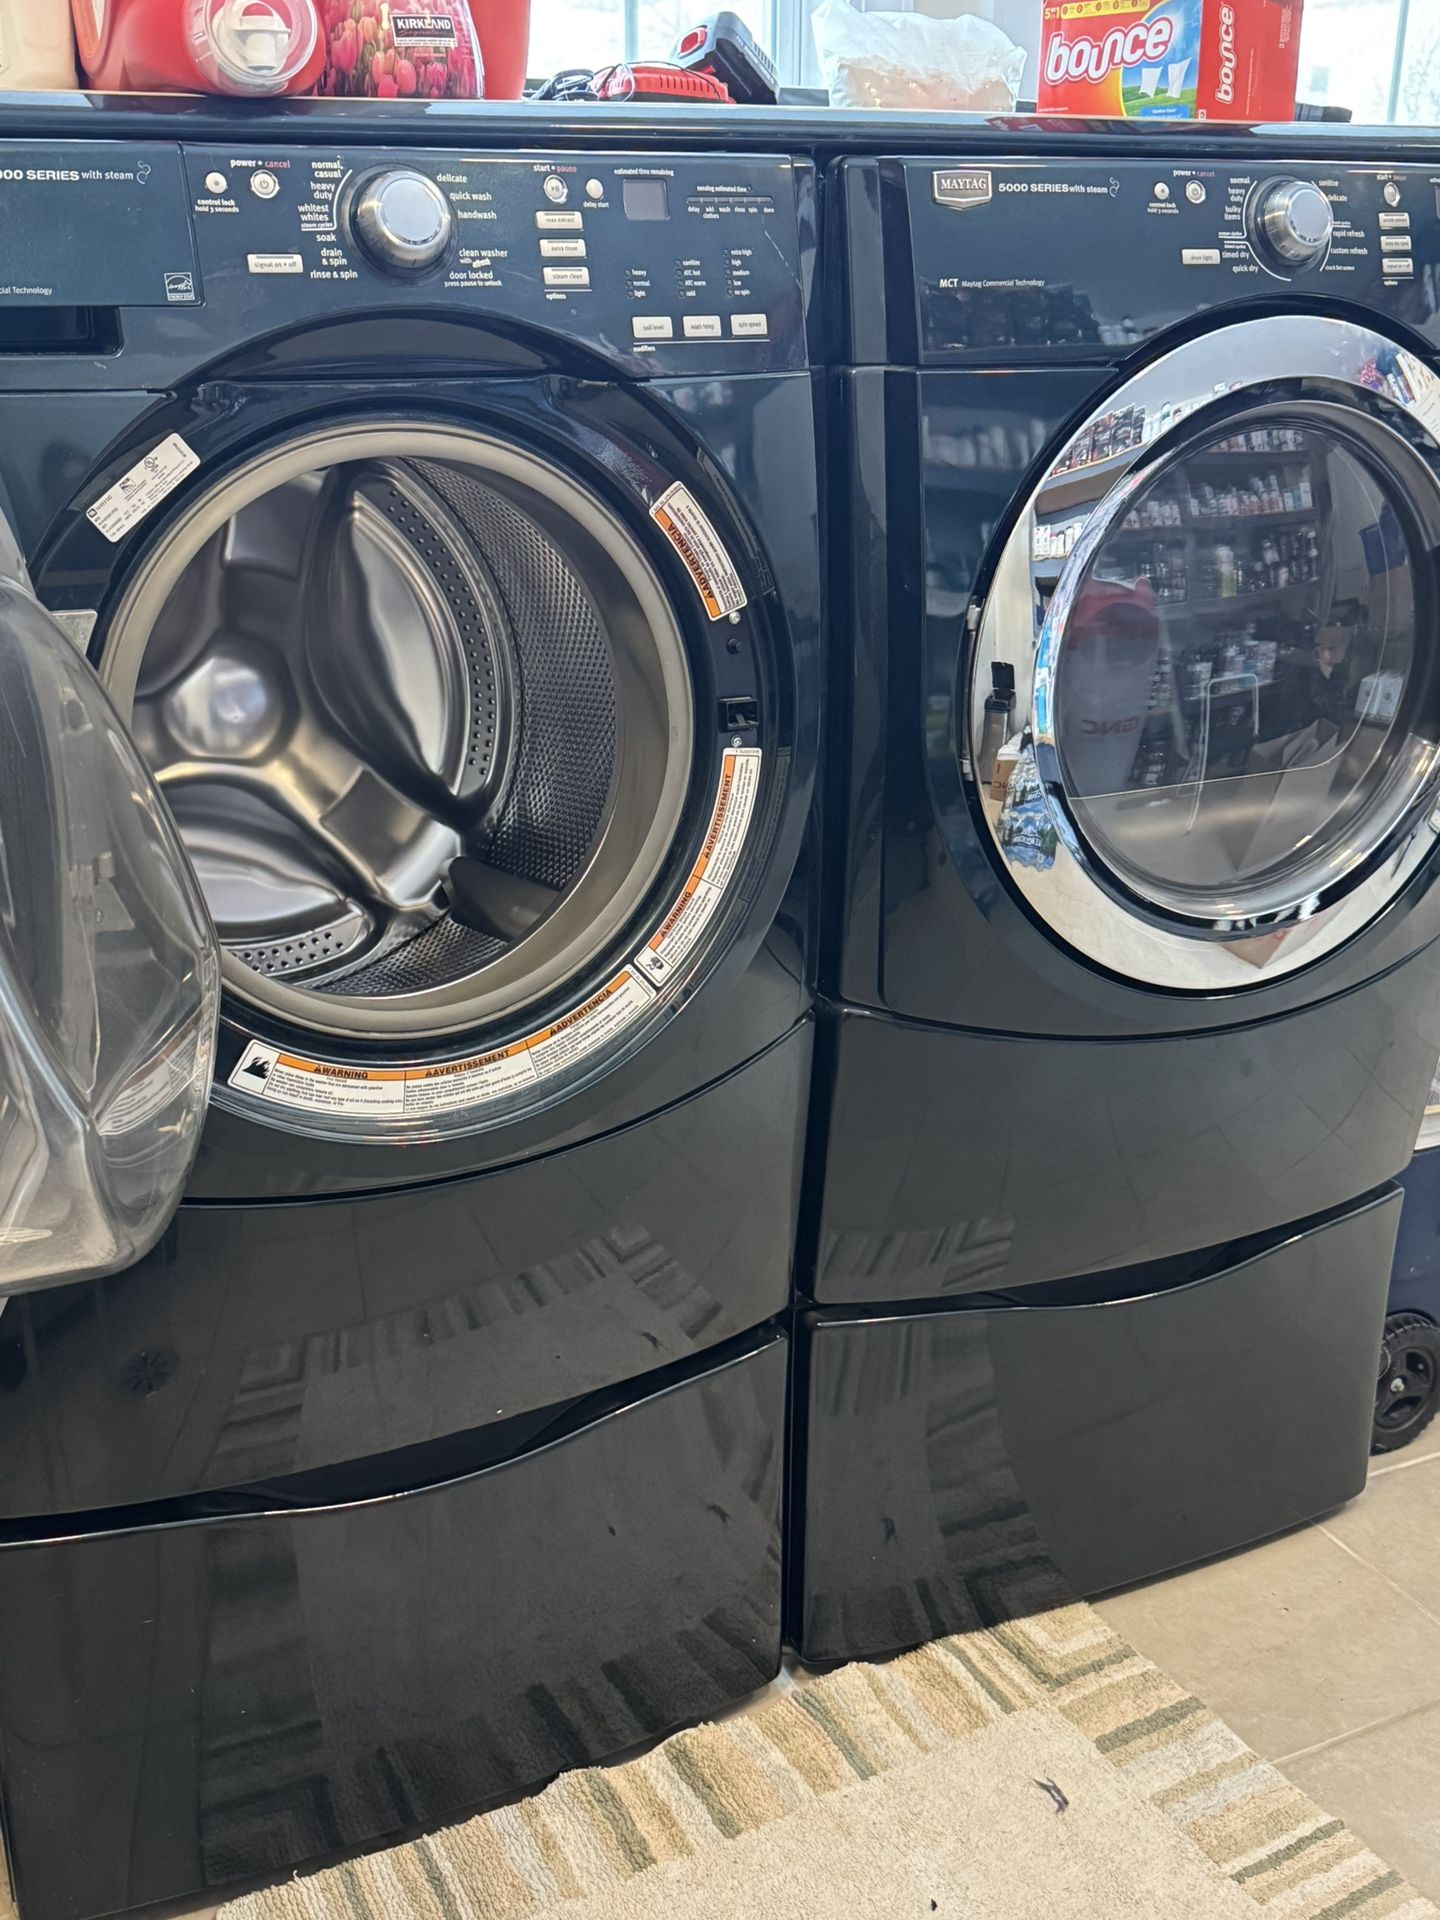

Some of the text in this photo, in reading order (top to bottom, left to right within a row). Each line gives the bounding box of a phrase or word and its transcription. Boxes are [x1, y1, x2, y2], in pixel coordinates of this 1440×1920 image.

[396, 18, 451, 29] KIRKLAND
[1046, 18, 1172, 80] bounce
[1216, 6, 1235, 102] bounce
[230, 160, 290, 168] power cancel
[26, 170, 80, 181] SERIES
[82, 170, 102, 180] with
[104, 172, 134, 181] steam
[314, 170, 342, 178] casual
[437, 174, 467, 183] delicate
[310, 182, 335, 191] heavy
[941, 178, 986, 190] MAYTAG
[998, 183, 1108, 194] 5000 SERIES with steam
[314, 191, 332, 200] duty
[450, 192, 492, 200] quick wash
[298, 203, 329, 212] whitest
[300, 213, 328, 221] whites
[458, 210, 496, 220] handwash
[316, 232, 336, 241] soak
[321, 248, 342, 257] drain
[459, 248, 508, 258] clean washer
[1240, 251, 1250, 259] dry
[254, 261, 274, 269] signal
[328, 256, 347, 267] spin
[1232, 264, 1258, 274] quick dry
[310, 270, 331, 278] rinse
[340, 270, 358, 280] spin
[450, 270, 494, 280] door locked
[940, 278, 958, 288] MCT
[962, 280, 982, 288] Maytag
[1015, 279, 1045, 287] Technology
[12, 286, 52, 296] Technology
[667, 523, 710, 592] ADVERTENCIA
[705, 774, 731, 853] AVERTISSEMENT
[665, 891, 692, 930] WARNING
[556, 989, 612, 1033] ADVERTENCIA
[434, 1050, 510, 1077] AVERTISSEMENT
[322, 1066, 369, 1080] WARNING
